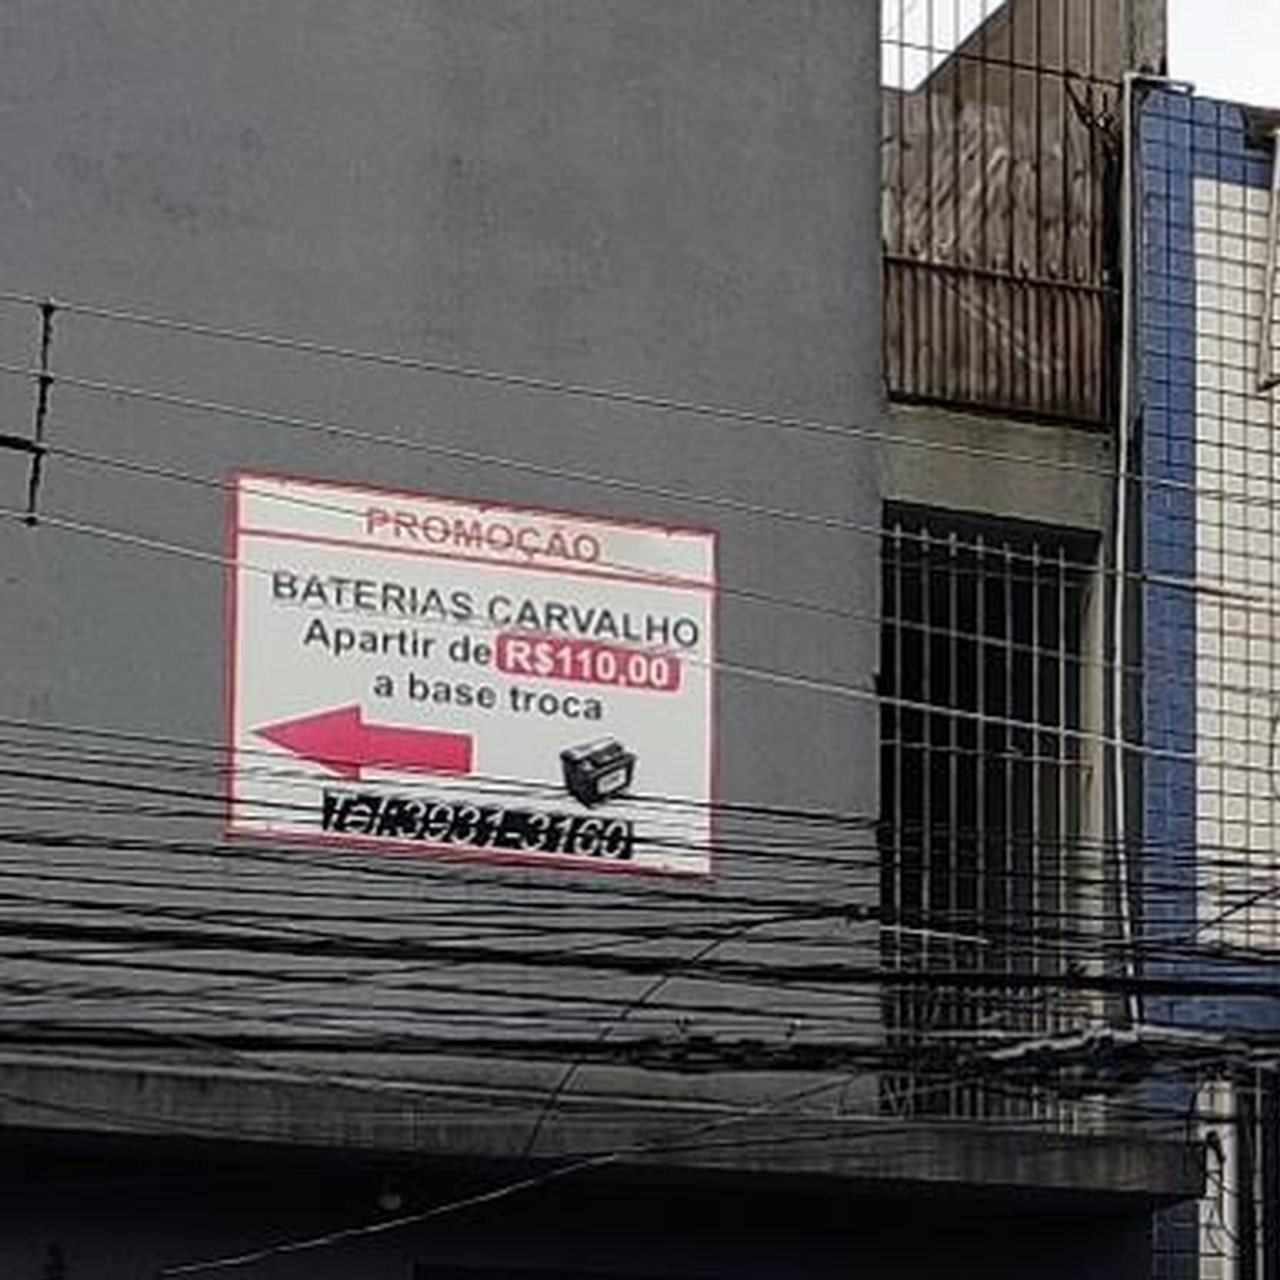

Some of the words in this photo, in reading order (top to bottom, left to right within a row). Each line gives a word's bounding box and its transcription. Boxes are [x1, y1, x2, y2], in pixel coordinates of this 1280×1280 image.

[366, 507, 601, 564] PROMOÇÃO
[272, 569, 475, 620] BATERIAS
[488, 596, 700, 648] CARVALHO
[303, 618, 436, 658] Apartir
[449, 635, 491, 665] de
[504, 640, 669, 686] R$110,00
[373, 673, 395, 697] a
[408, 672, 496, 709] base
[509, 687, 603, 720] troca
